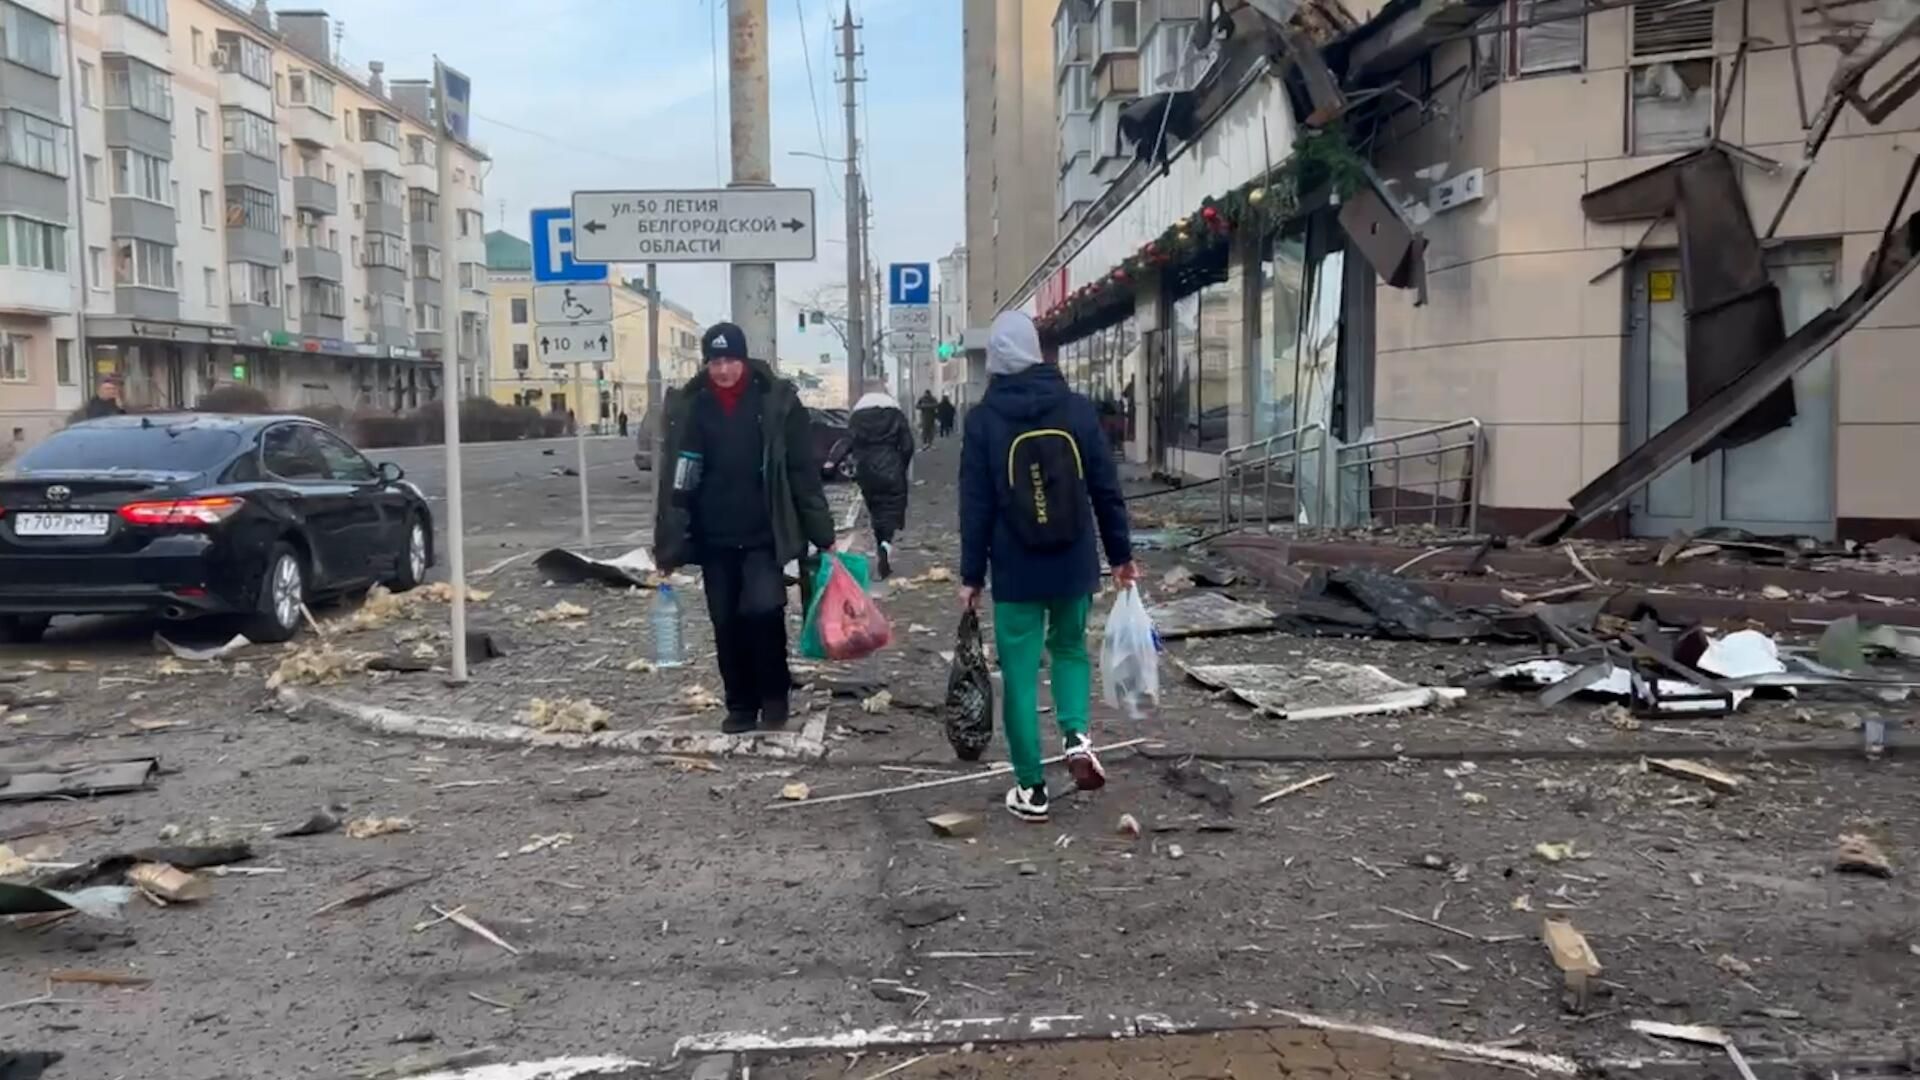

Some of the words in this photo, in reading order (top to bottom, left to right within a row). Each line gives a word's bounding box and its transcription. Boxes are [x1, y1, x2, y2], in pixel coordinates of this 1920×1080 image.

[663, 199, 719, 214] ЛЕТИЯ
[638, 217, 777, 234] БЕЛГОРОДСКОЙ
[639, 239, 721, 254] ОБЛАСТИ
[900, 268, 923, 301] P
[554, 337, 570, 351] 10
[1029, 462, 1048, 524] SKECHERS
